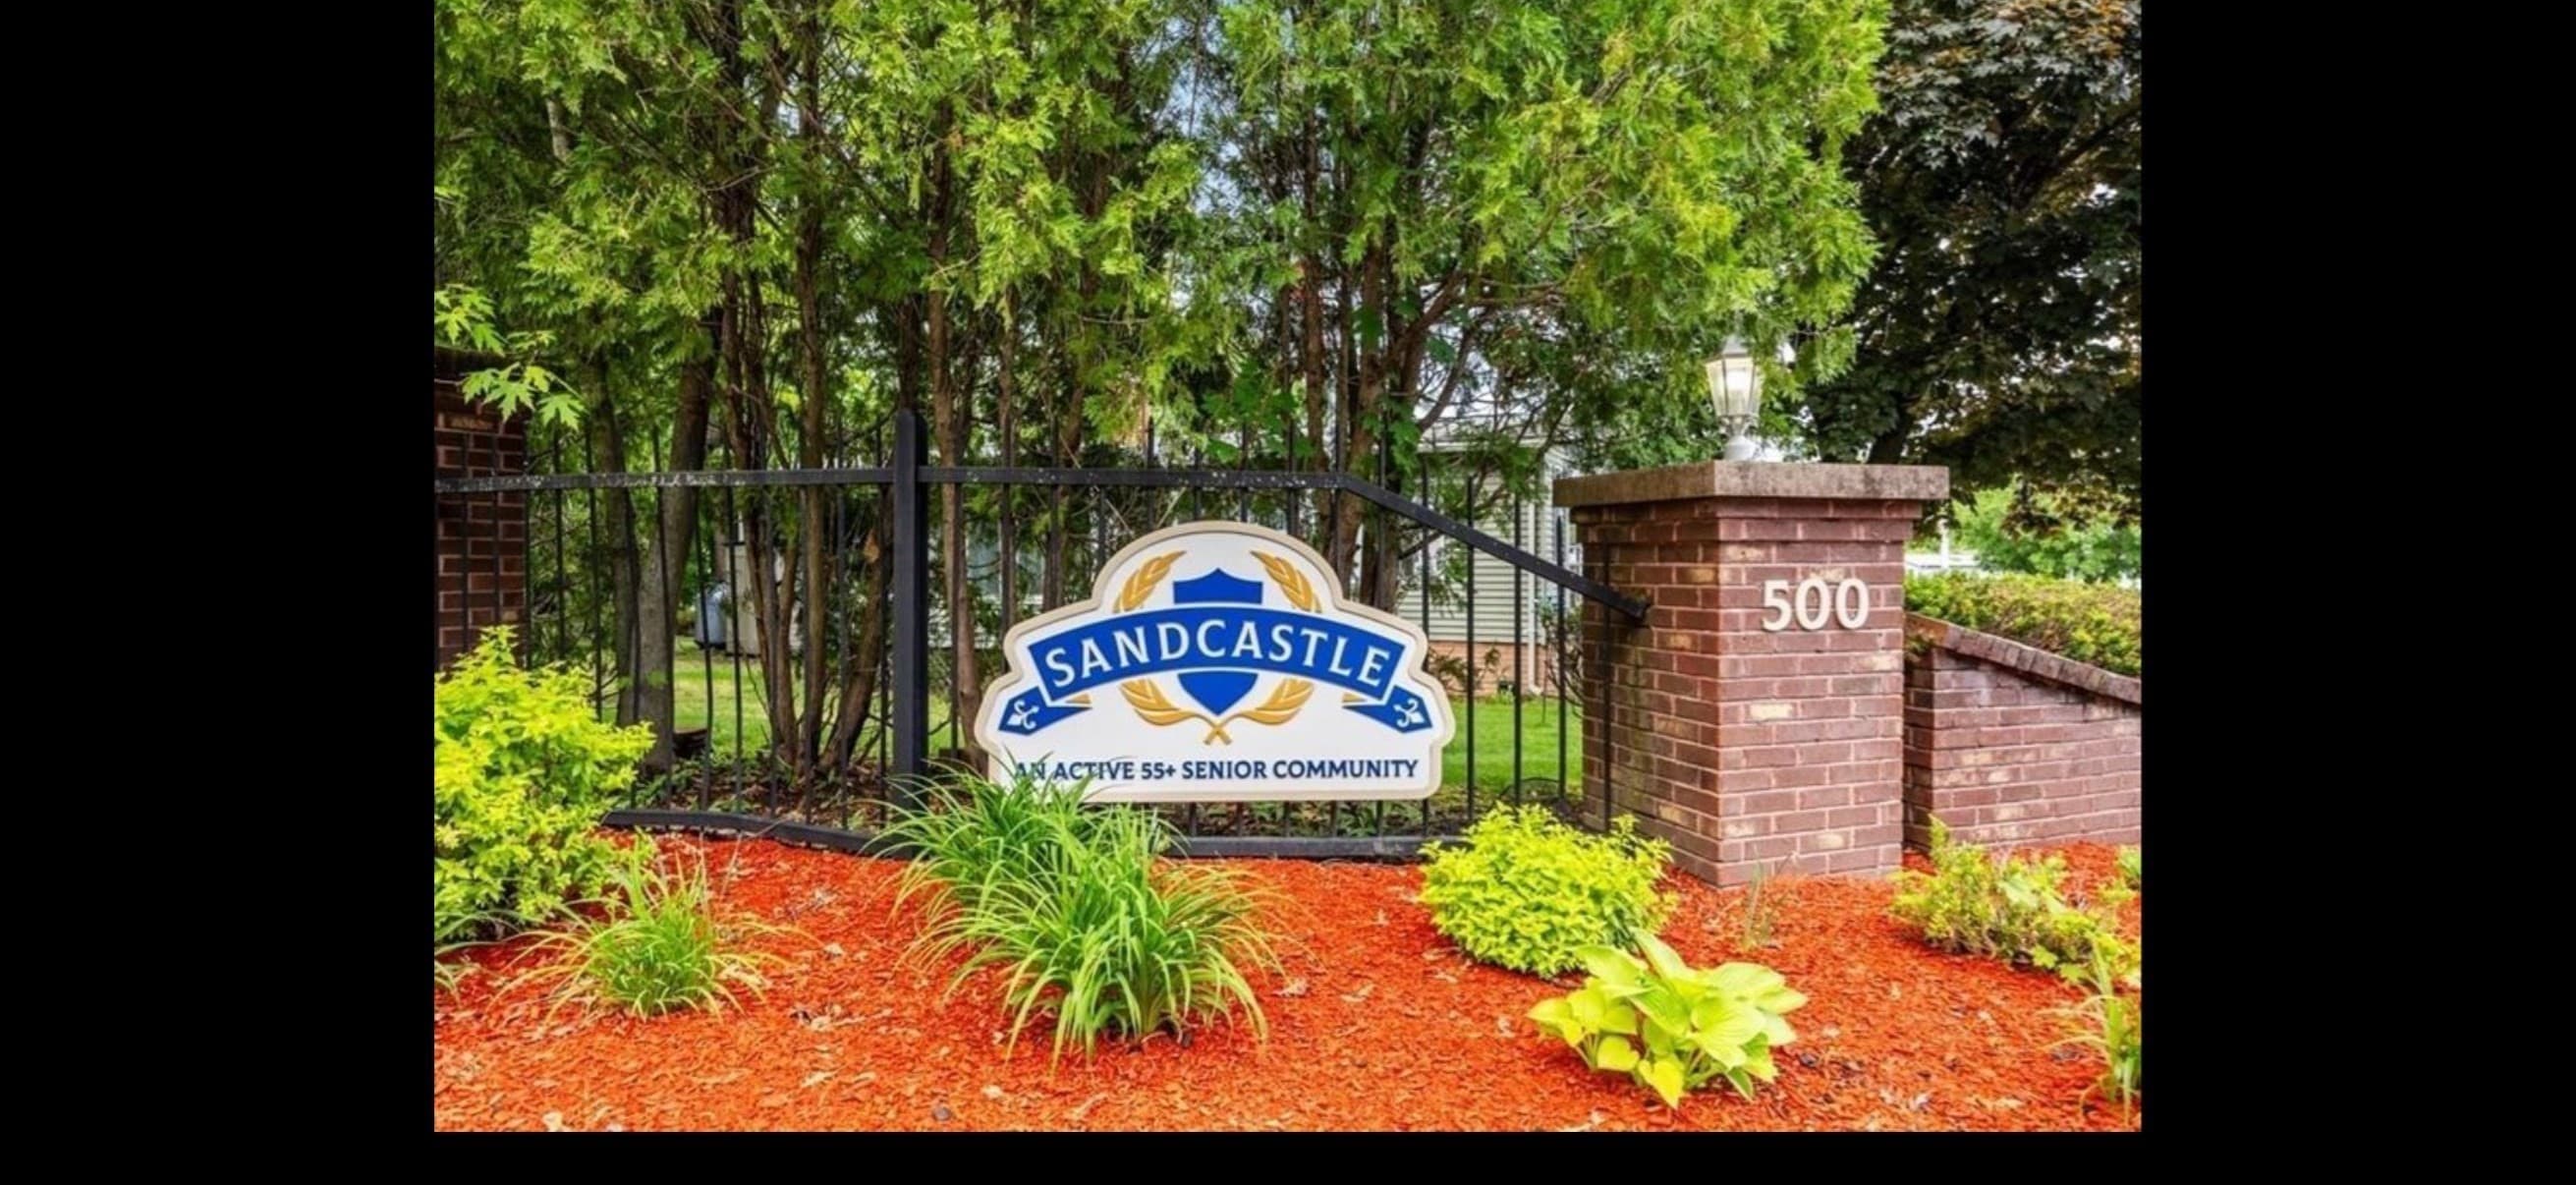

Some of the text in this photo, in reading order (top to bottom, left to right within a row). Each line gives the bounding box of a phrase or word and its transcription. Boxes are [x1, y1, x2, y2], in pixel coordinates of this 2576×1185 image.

[1762, 578, 1870, 631] 500
[1045, 618, 1391, 687] SANDCASTLE
[1015, 760, 1419, 780] AN ACTIVE 55+ SENIOR COMMUNITY
